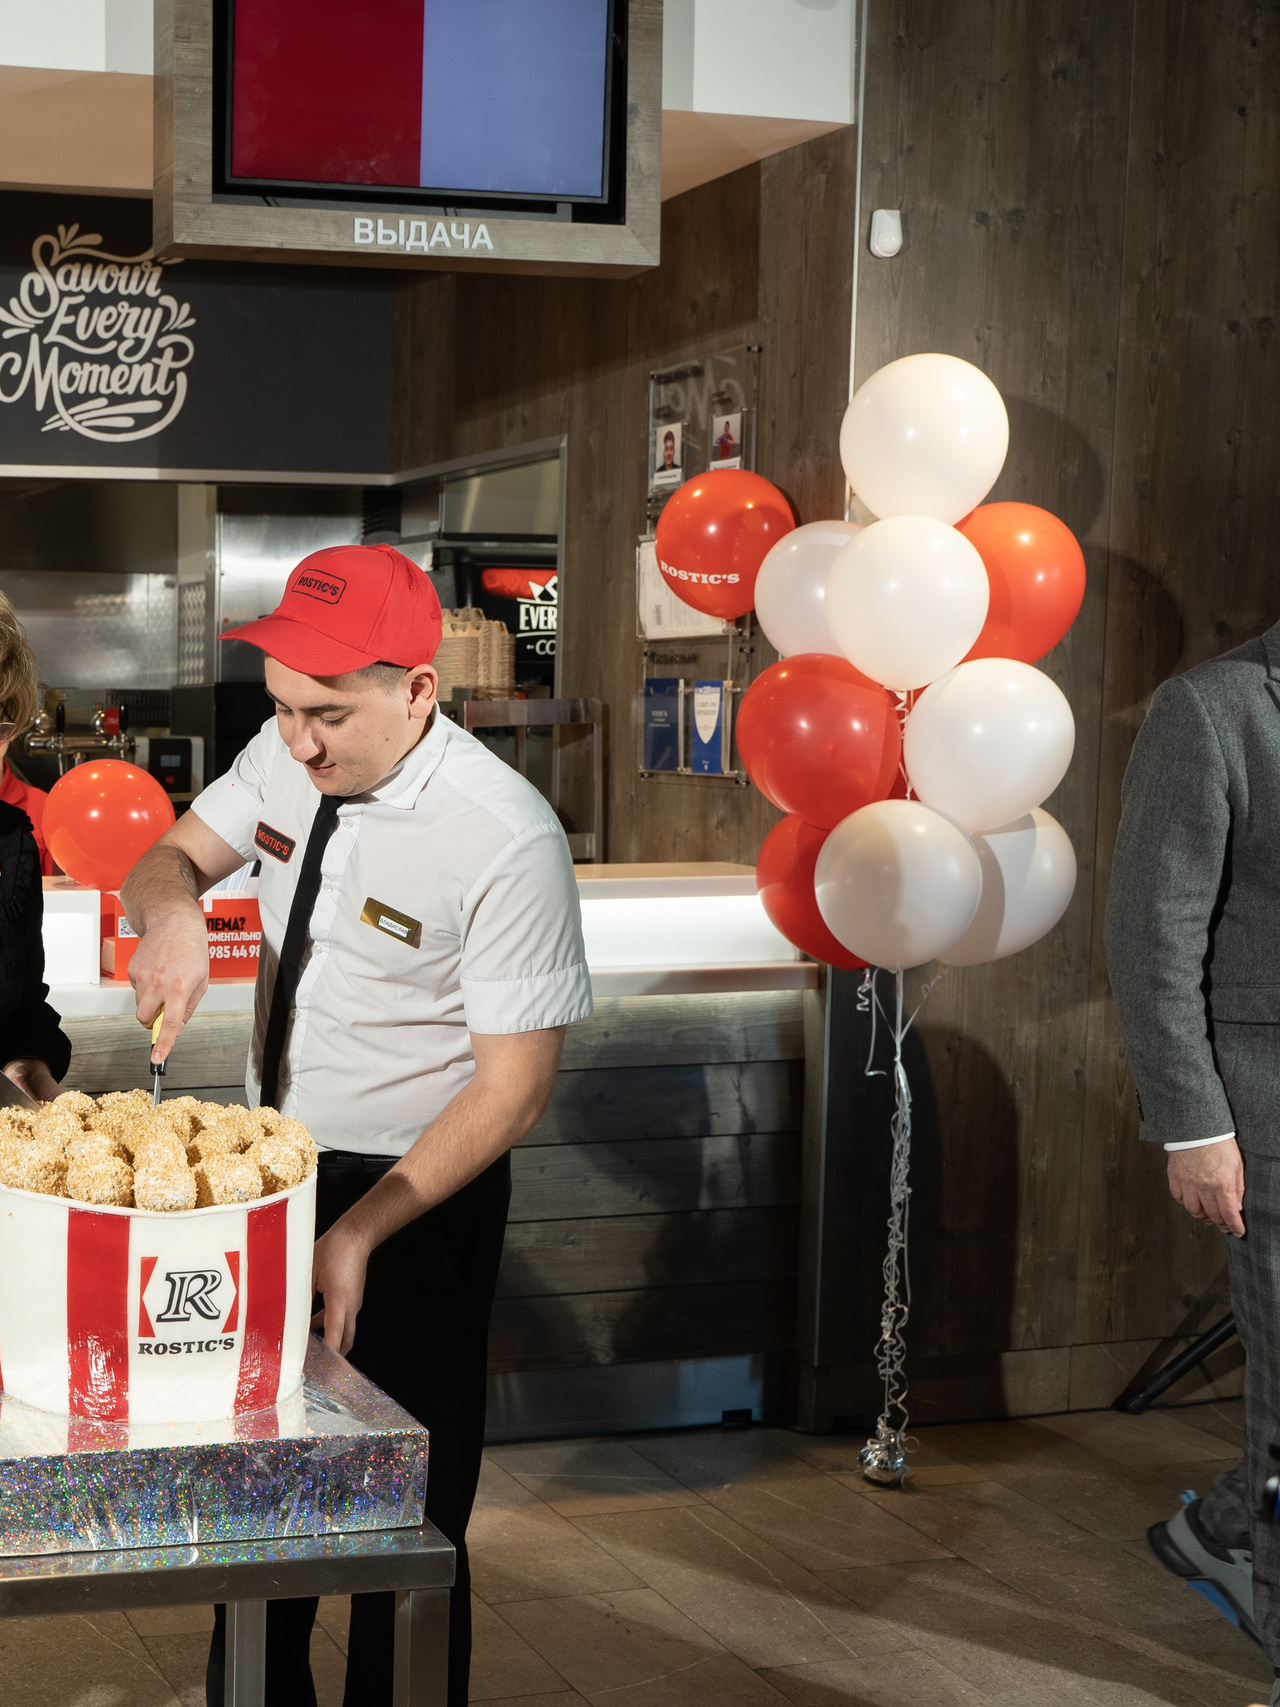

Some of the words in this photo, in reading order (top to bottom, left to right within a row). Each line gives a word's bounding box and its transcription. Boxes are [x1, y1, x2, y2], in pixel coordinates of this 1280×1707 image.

[353, 218, 494, 252] ВЫДАЧА
[20, 234, 163, 318] Savour
[43, 295, 164, 363] Every
[297, 576, 339, 597] ROSTIC'S
[660, 560, 740, 585] ROSTIC'S
[257, 828, 290, 856] ROSTIC'S
[209, 945, 231, 959] 985
[232, 945, 247, 958] 44
[156, 1269, 222, 1322] R
[138, 1338, 235, 1355] ROSTIC'S
